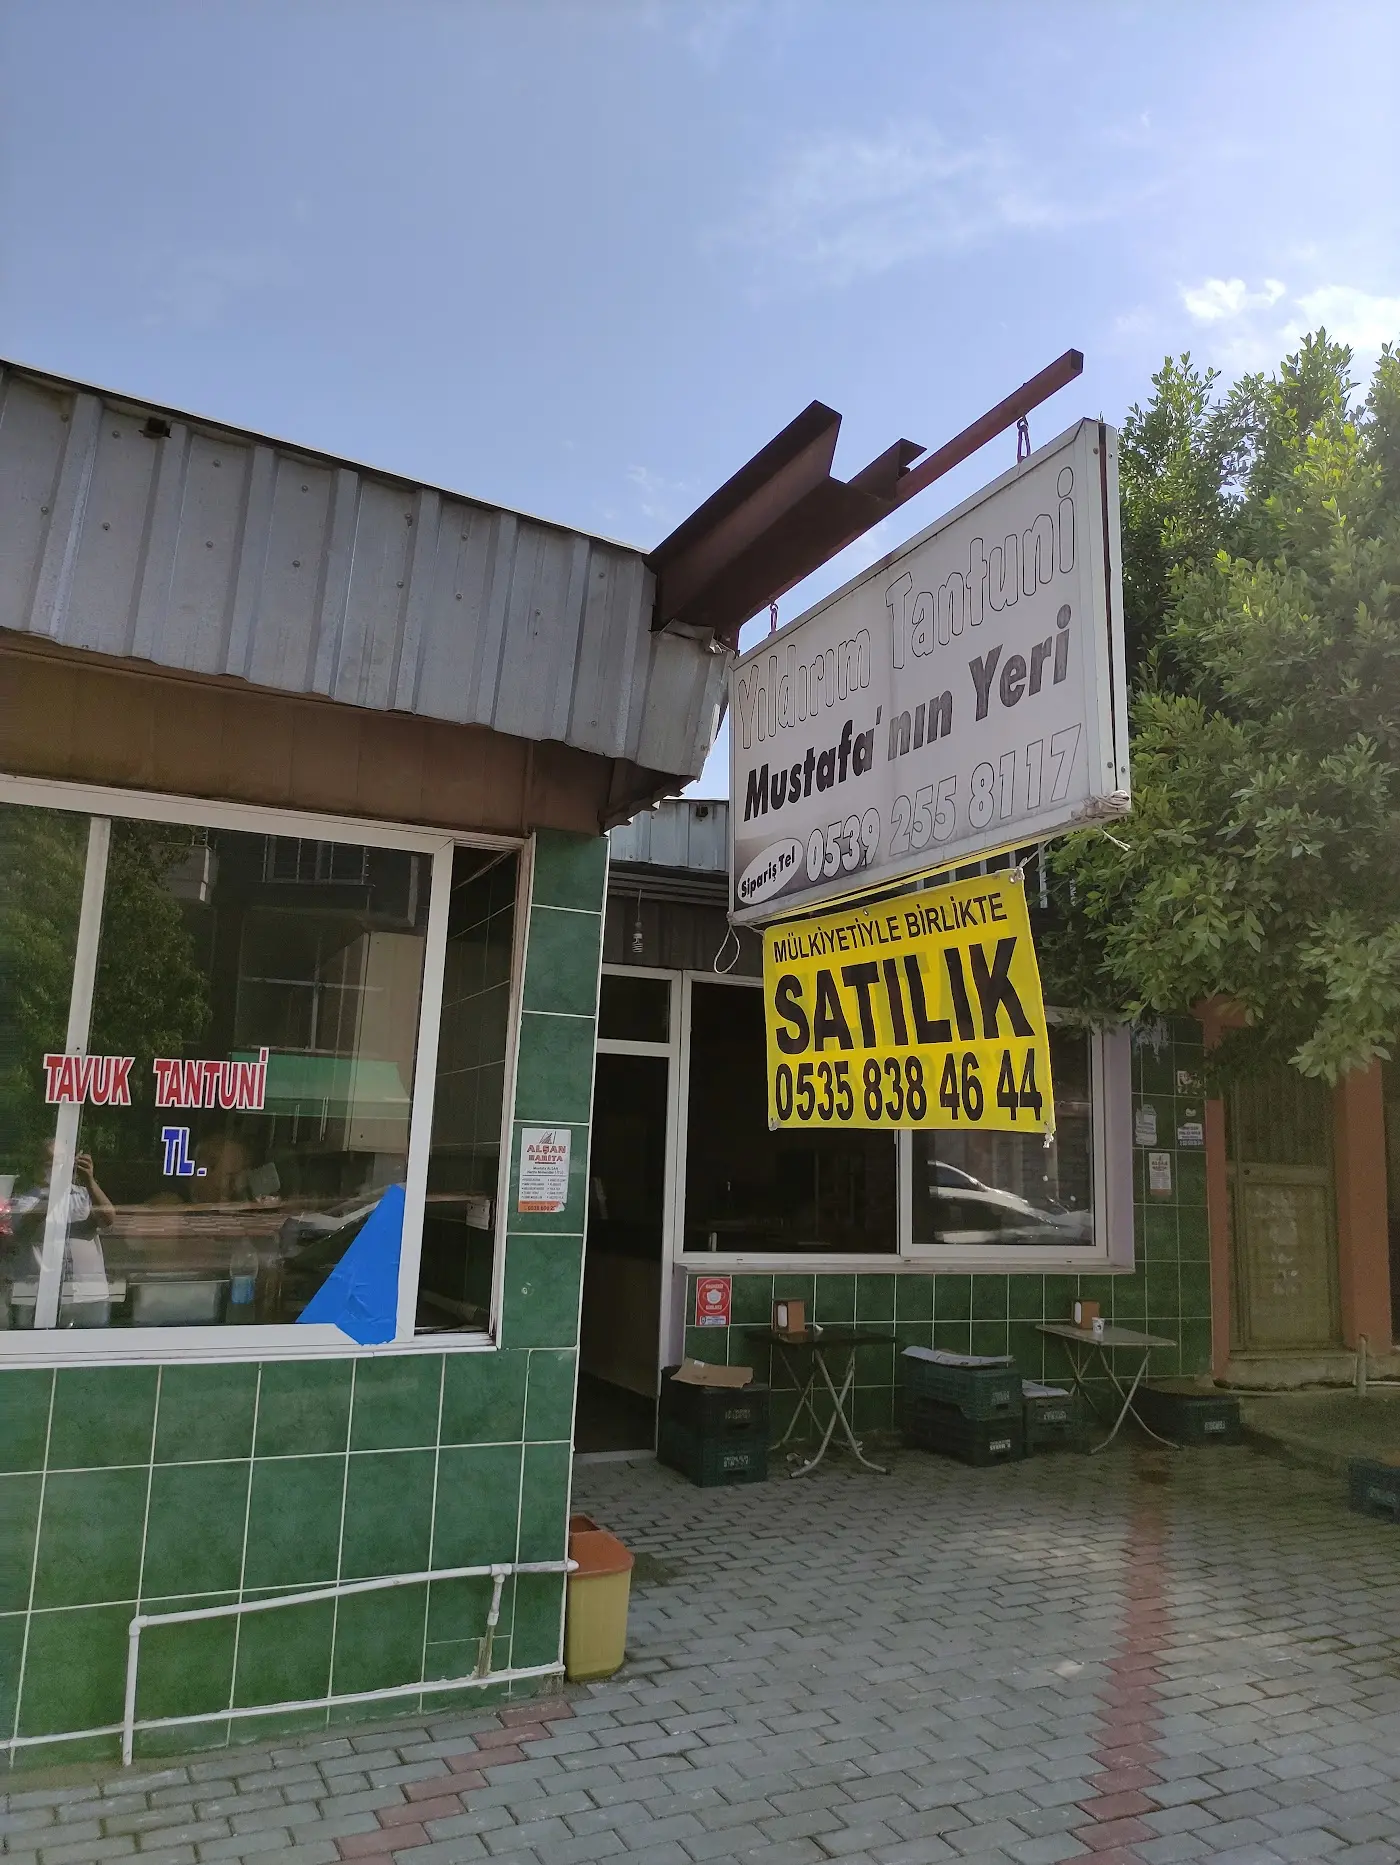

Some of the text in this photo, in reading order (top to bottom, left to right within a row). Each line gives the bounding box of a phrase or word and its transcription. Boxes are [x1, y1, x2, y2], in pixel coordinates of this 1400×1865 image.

[738, 466, 1075, 749] Yıldırım Tantuni
[743, 604, 1072, 822] Mustafa'nın Yeri
[806, 807, 881, 882] 0539
[889, 775, 957, 857] 255
[741, 845, 796, 898] Sipariş Tel
[773, 892, 1008, 964] MÜLKİYETİYLE BİRLİKTE
[774, 936, 1035, 1055] SATILIK
[43, 1047, 270, 1110] TAVUK TANTUNİ
[775, 1047, 1043, 1122] 0535 838 46 44
[161, 1126, 208, 1176] TL.
